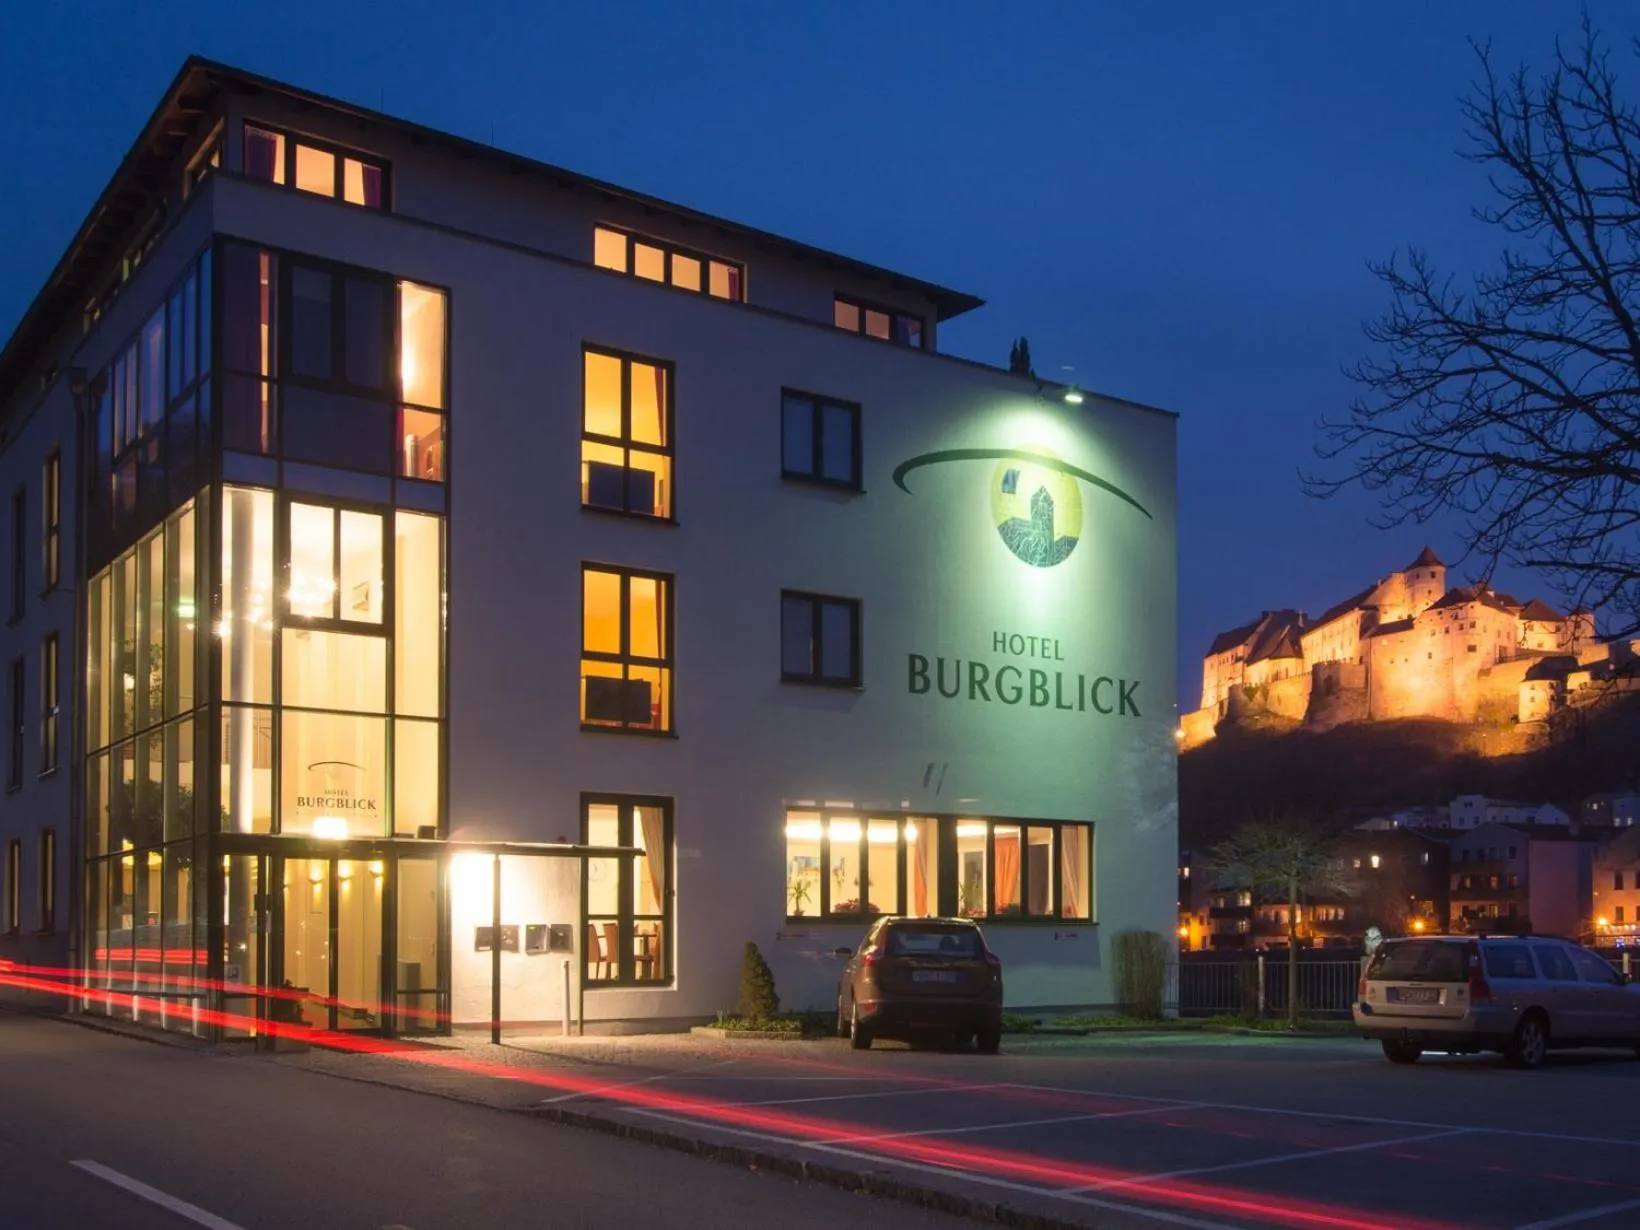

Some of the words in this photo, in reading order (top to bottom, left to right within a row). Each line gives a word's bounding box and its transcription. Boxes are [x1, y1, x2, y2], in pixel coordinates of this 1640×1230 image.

[993, 631, 1065, 661] HOTEL
[908, 653, 1141, 717] BURGBLICK
[296, 796, 377, 810] BURGBLICK
